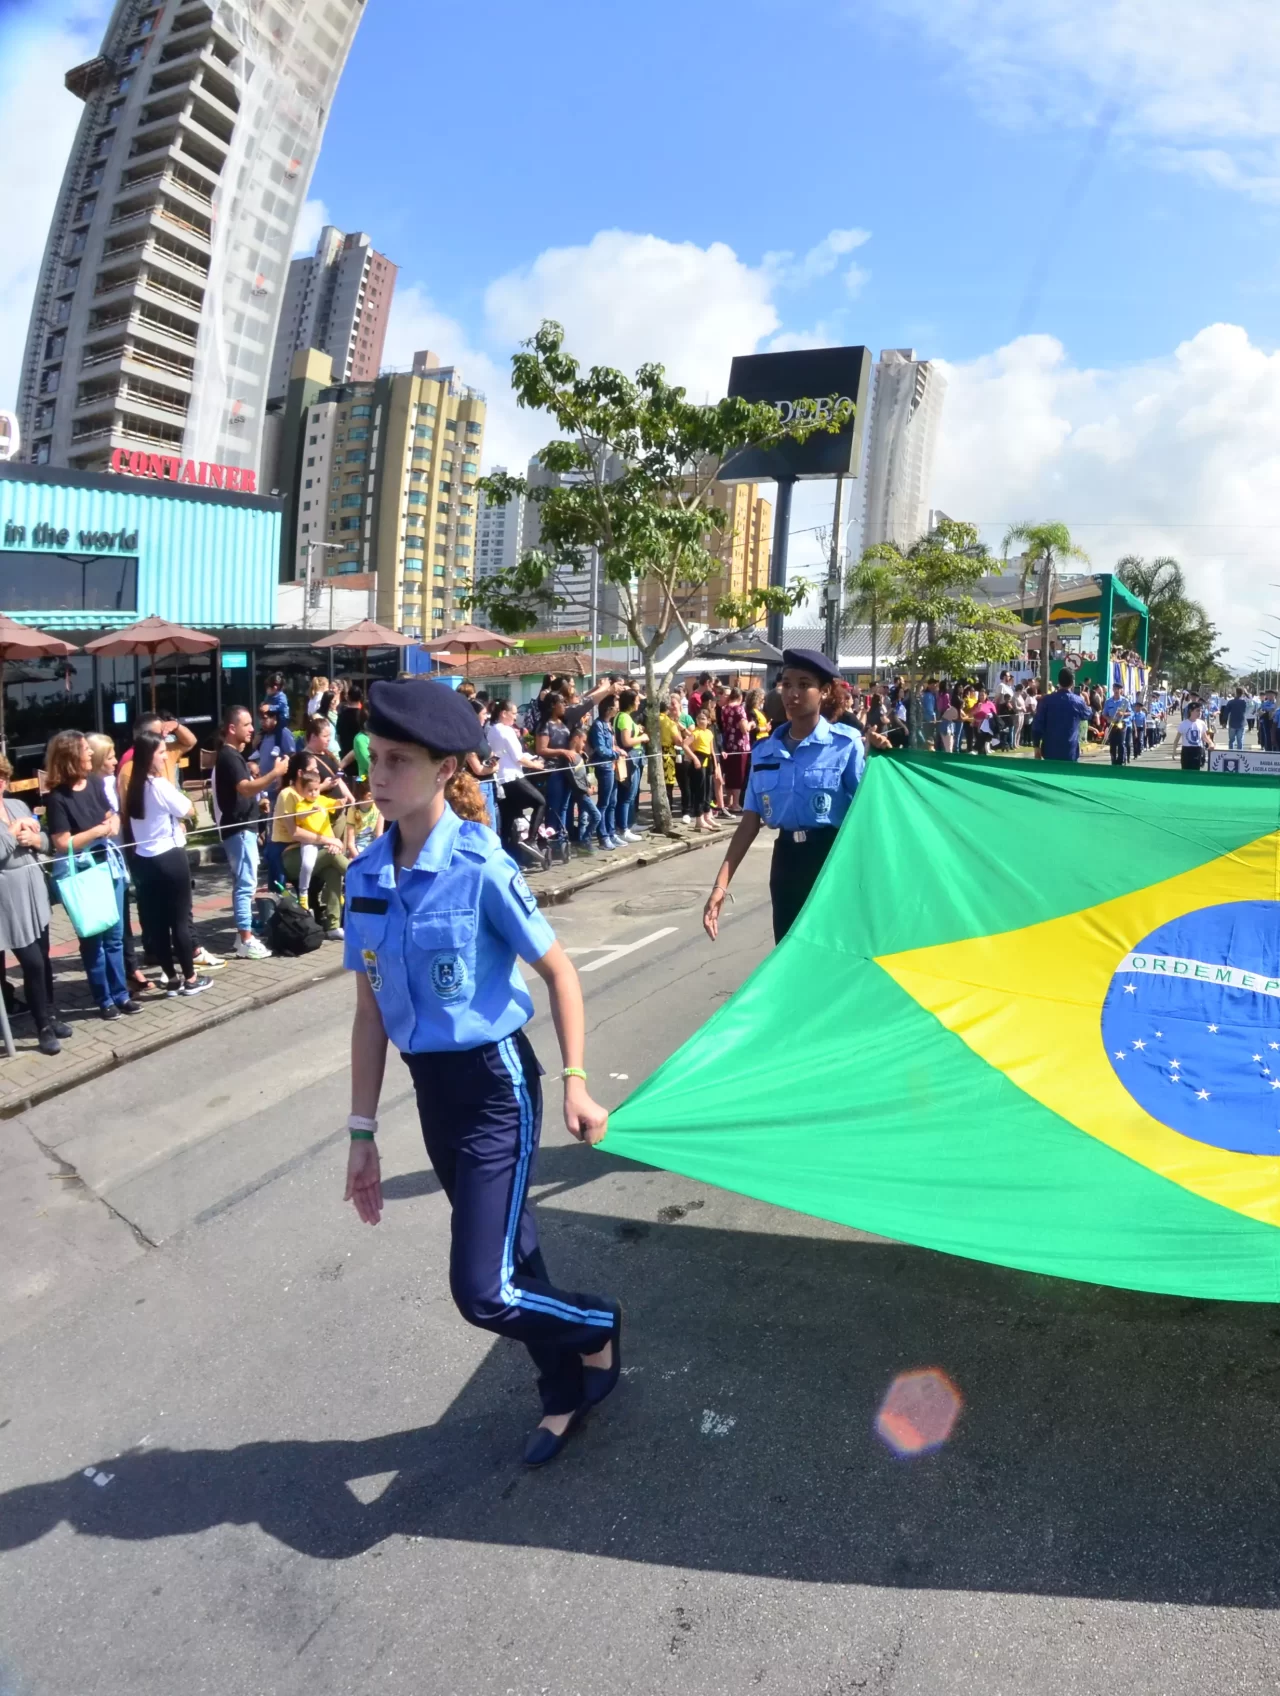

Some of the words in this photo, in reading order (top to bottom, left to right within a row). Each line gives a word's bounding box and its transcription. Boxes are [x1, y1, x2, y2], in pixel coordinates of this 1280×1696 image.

[111, 447, 257, 493] CONTAINER
[4, 518, 26, 547] in
[32, 521, 70, 547] the
[77, 527, 139, 550] world
[1131, 957, 1233, 982] ORDEM
[1241, 974, 1256, 988] E
